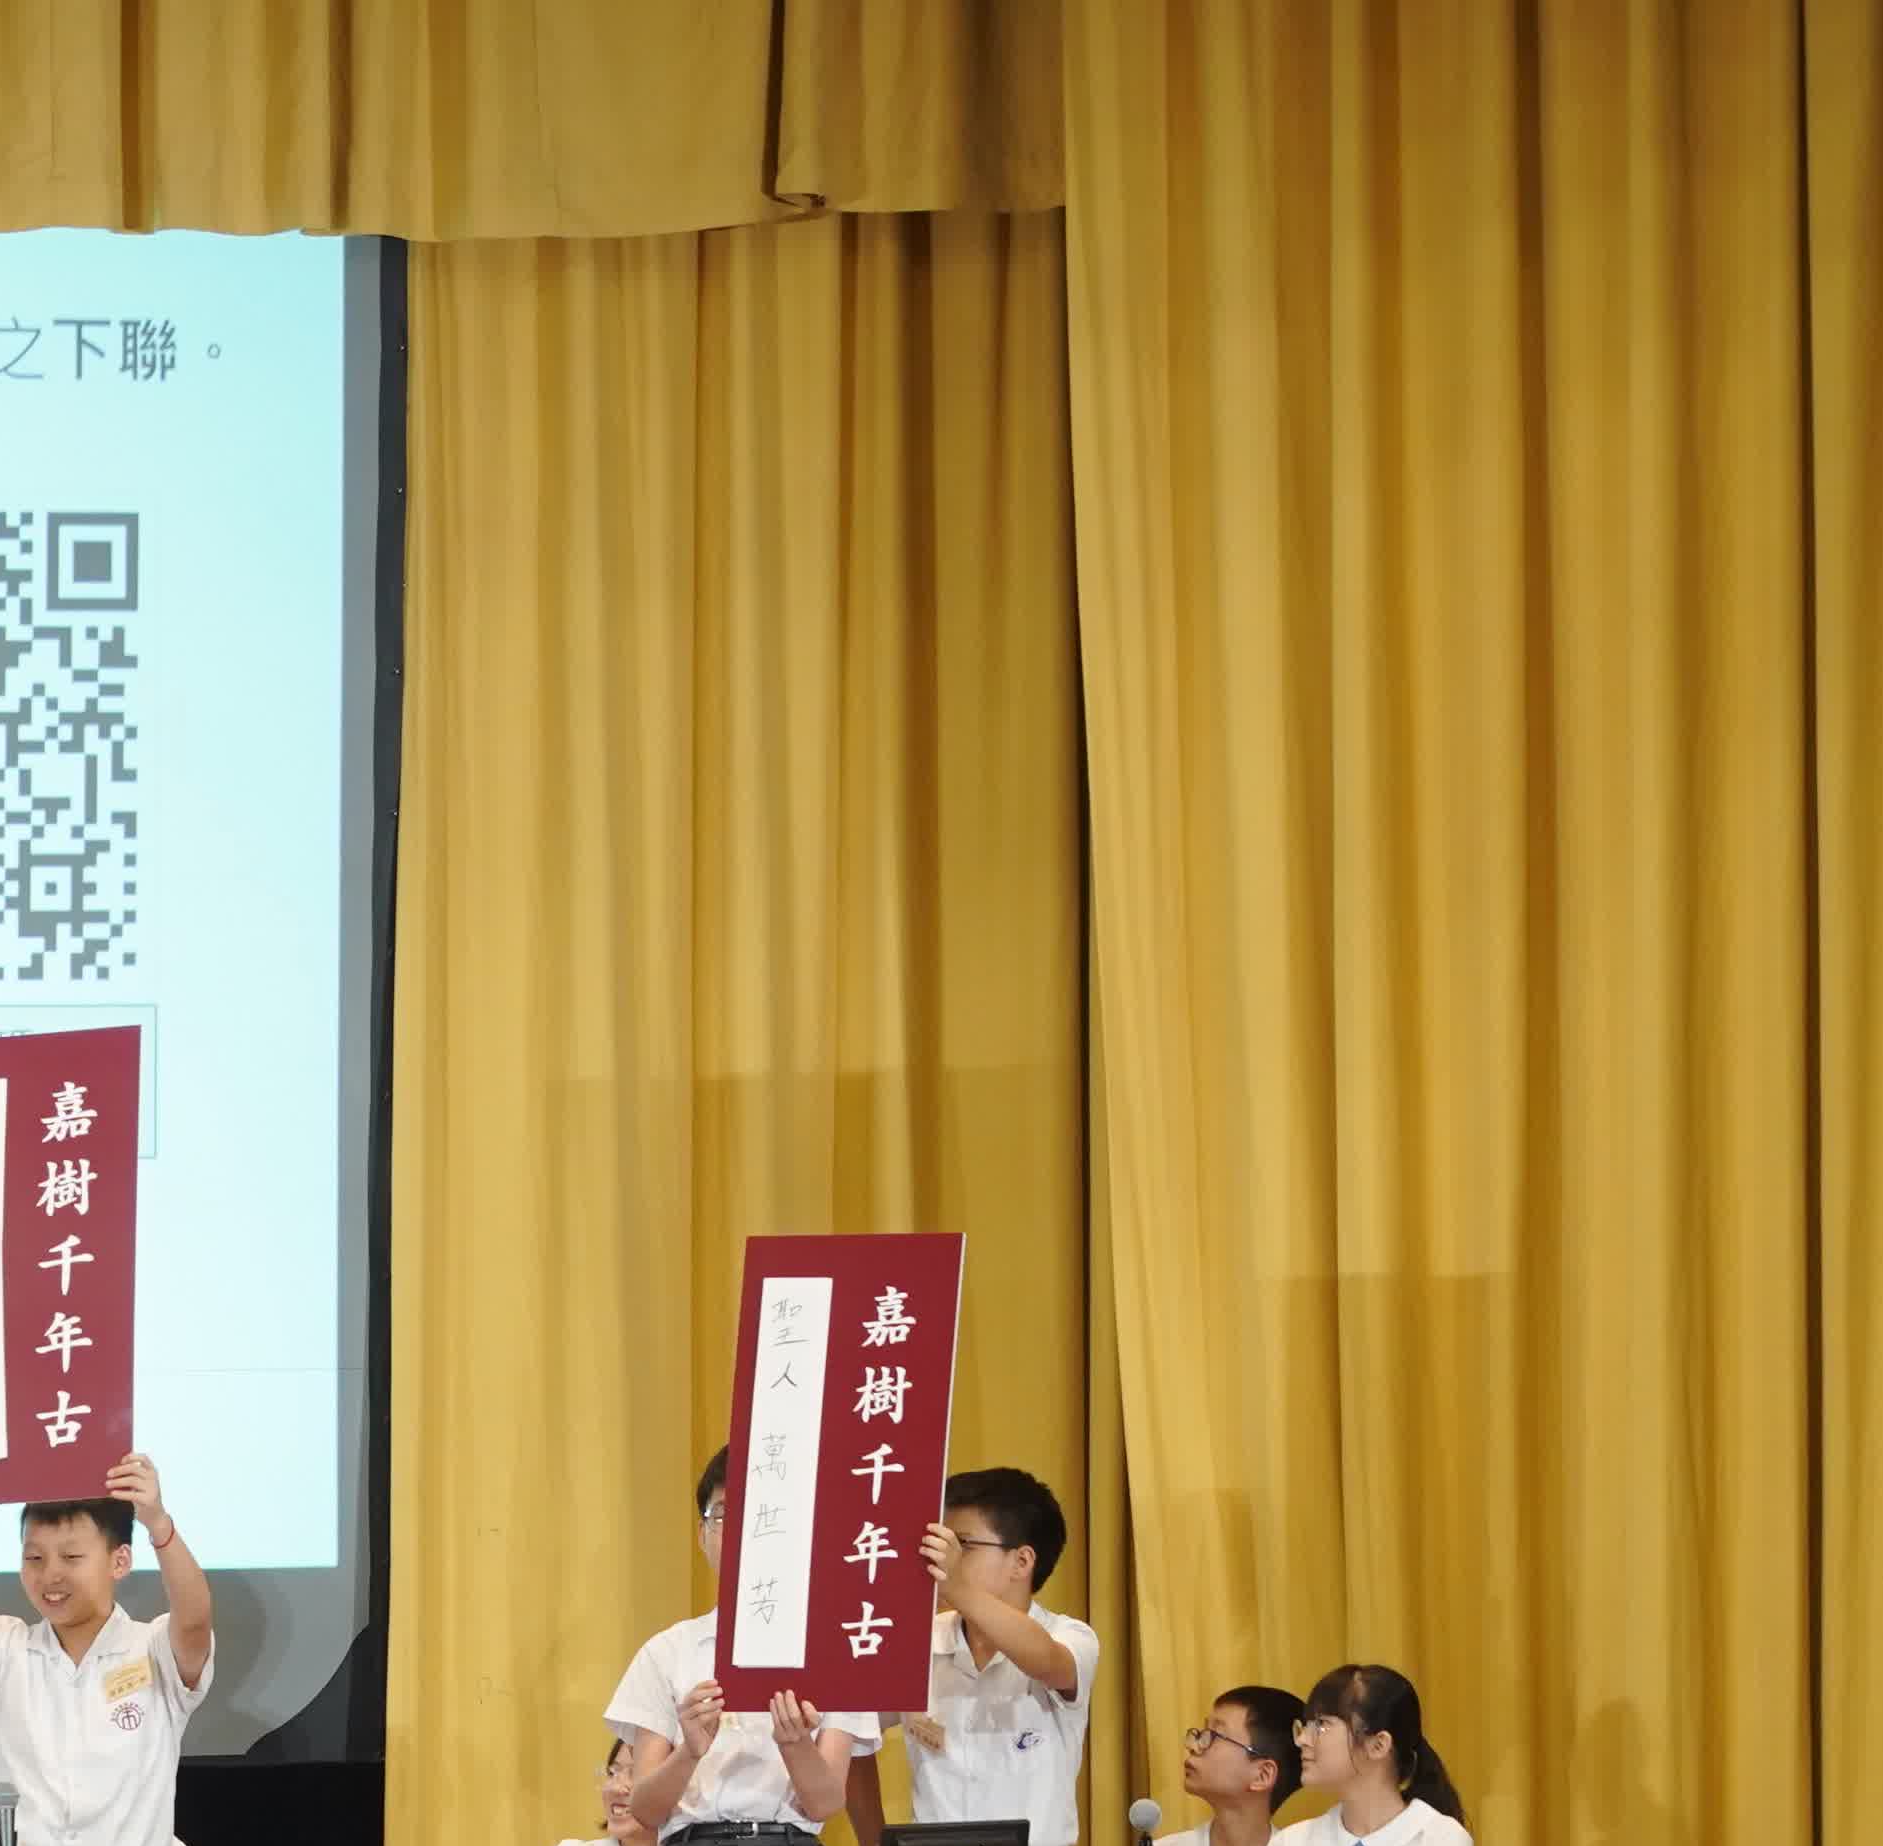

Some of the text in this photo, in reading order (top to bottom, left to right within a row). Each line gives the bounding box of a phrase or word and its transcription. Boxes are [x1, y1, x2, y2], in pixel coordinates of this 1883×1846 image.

[35, 1080, 98, 1448] 嘉樹千年古
[840, 1285, 918, 1659] 嘉樹千年古
